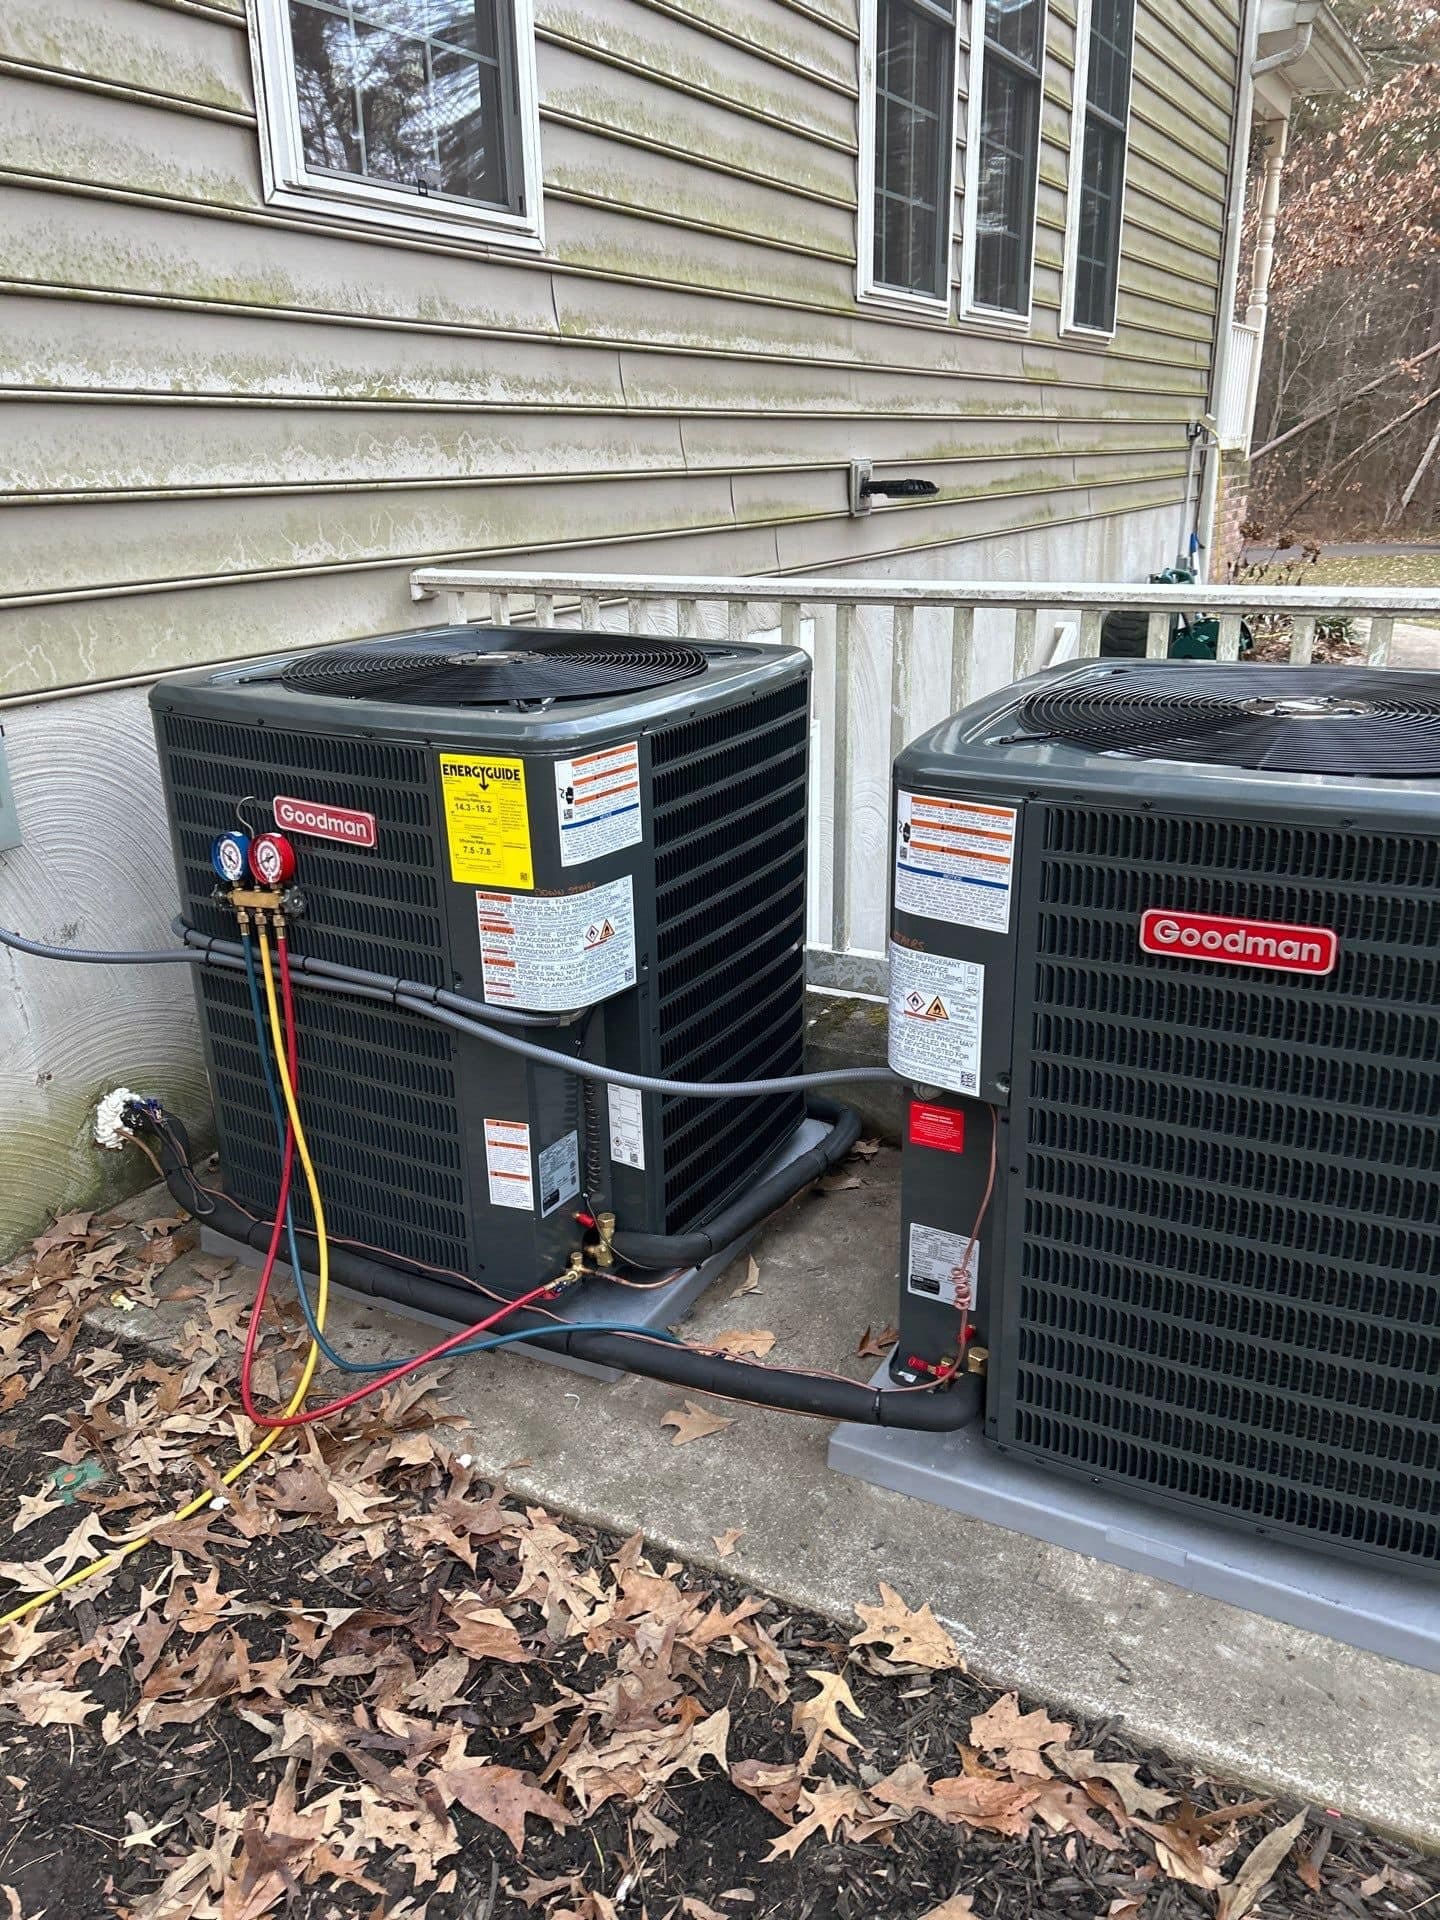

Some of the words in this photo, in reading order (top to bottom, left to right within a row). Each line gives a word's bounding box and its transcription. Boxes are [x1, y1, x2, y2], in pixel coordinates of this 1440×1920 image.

[443, 764, 521, 781] ENERGYGUIDE
[281, 804, 367, 838] Goodman
[1153, 919, 1322, 963] Goodman
